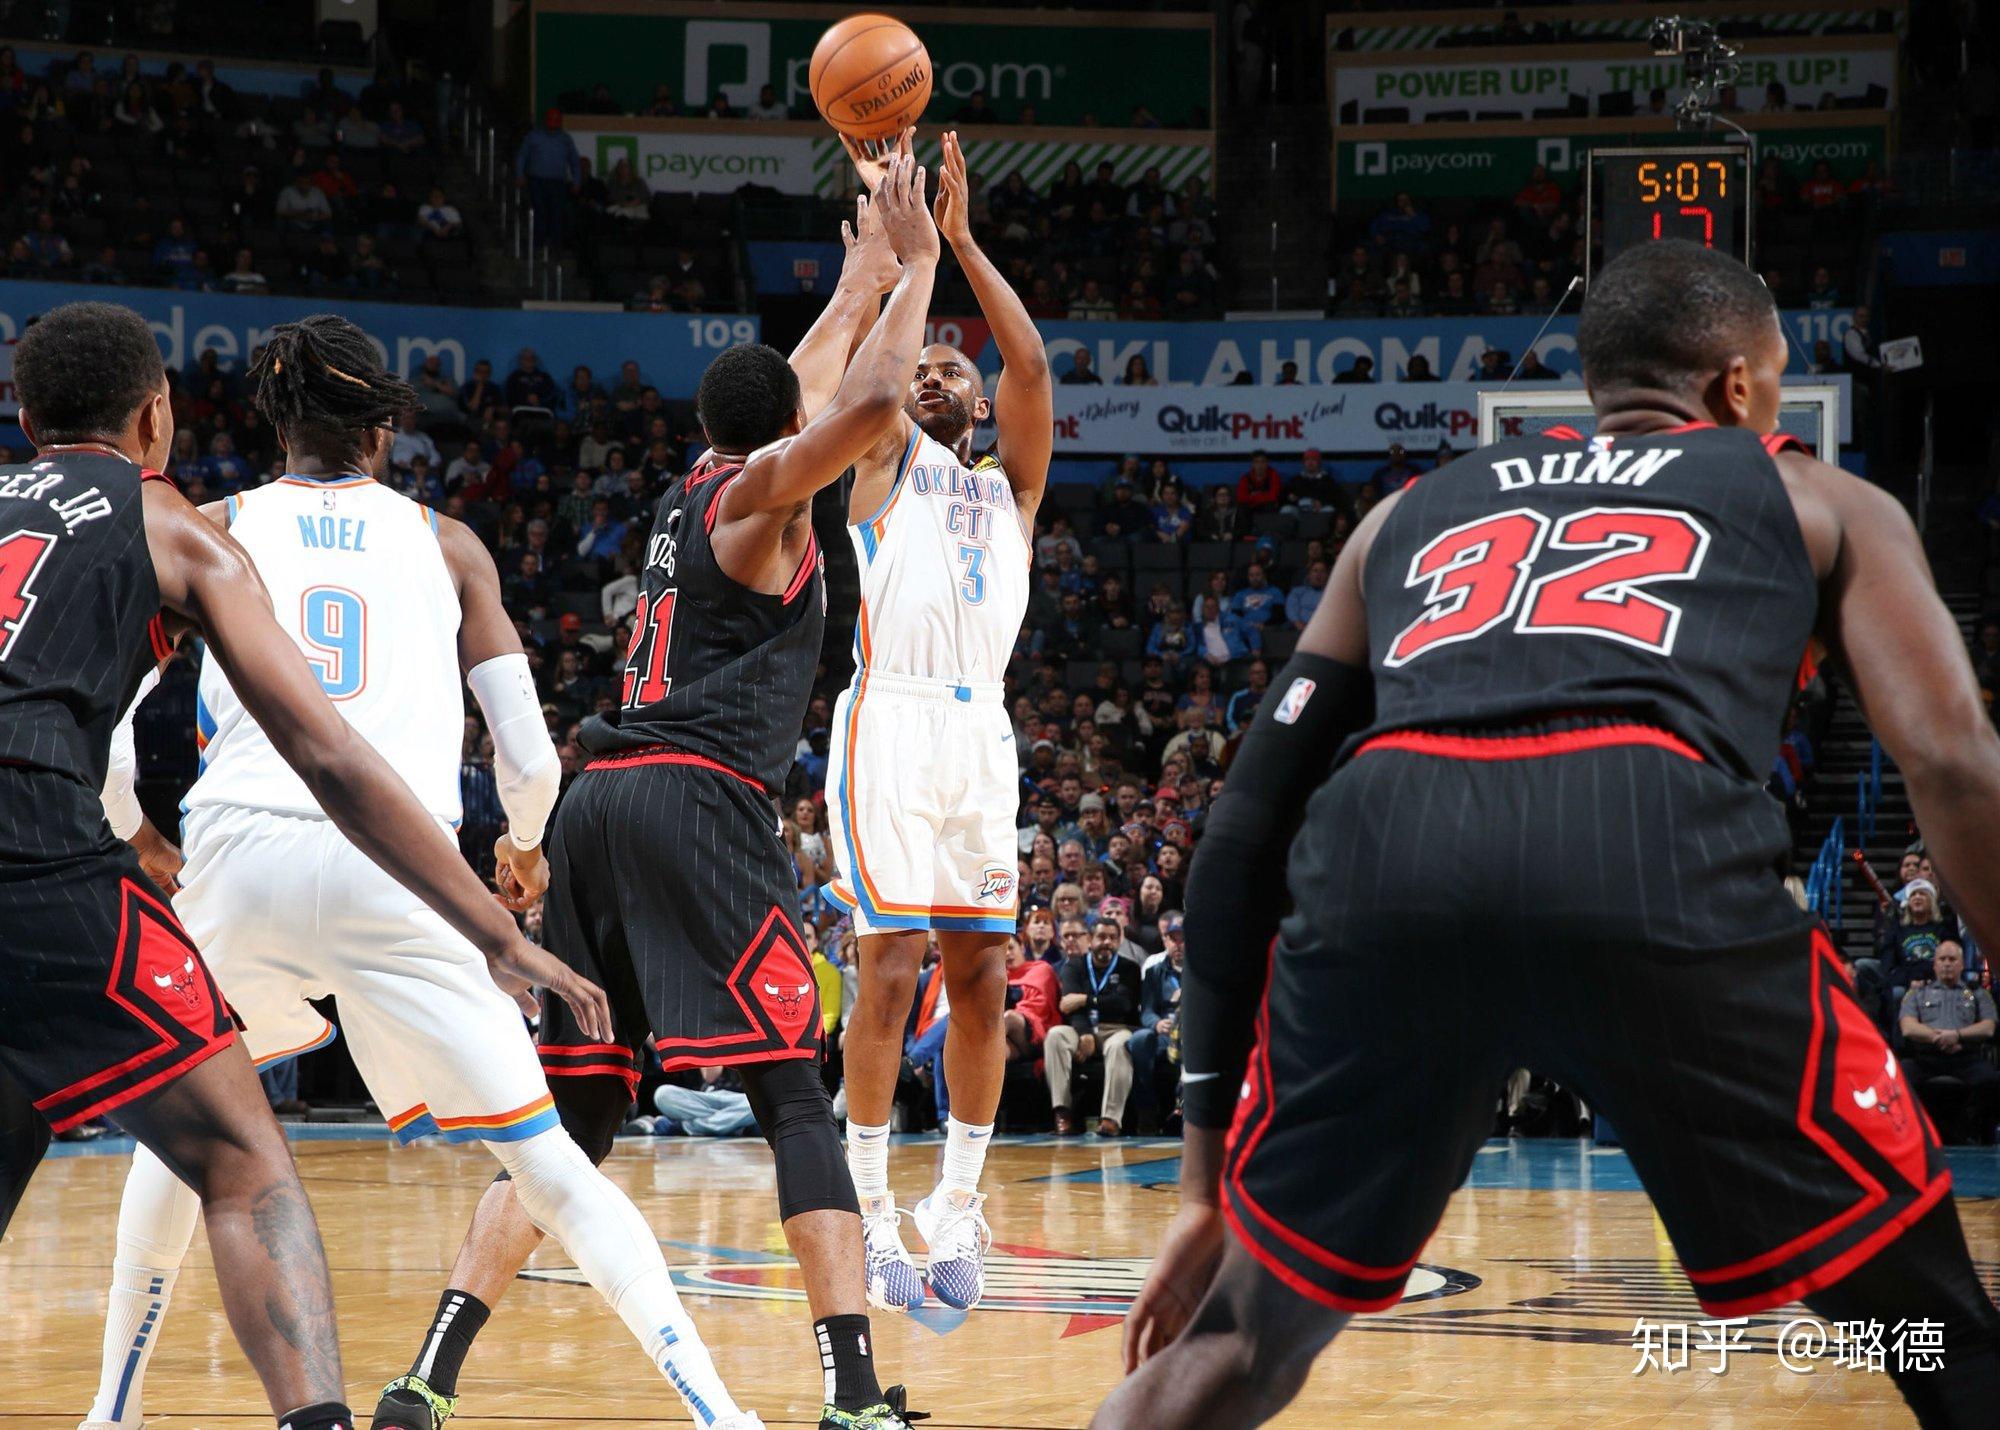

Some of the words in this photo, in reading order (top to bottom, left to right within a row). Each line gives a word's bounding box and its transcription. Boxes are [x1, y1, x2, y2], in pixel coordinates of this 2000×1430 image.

[850, 62, 925, 121] SPALDING
[1376, 71, 1501, 99] POWER
[1511, 68, 1570, 94] UP!
[1787, 58, 1850, 85] UP!
[646, 153, 781, 180] paycom
[1391, 150, 1492, 174] paycom
[1637, 161, 1728, 203] 5:07
[688, 318, 756, 347] 109
[1797, 314, 1855, 343] 110
[1044, 335, 1492, 386] OKLAHOMA
[1158, 405, 1304, 439] QuikPrint
[1491, 448, 1682, 491] DUNN
[297, 515, 366, 553] NOEL
[957, 542, 986, 607] 3
[1383, 507, 1712, 668] 32
[300, 584, 367, 702] 9
[621, 587, 678, 711] 21
